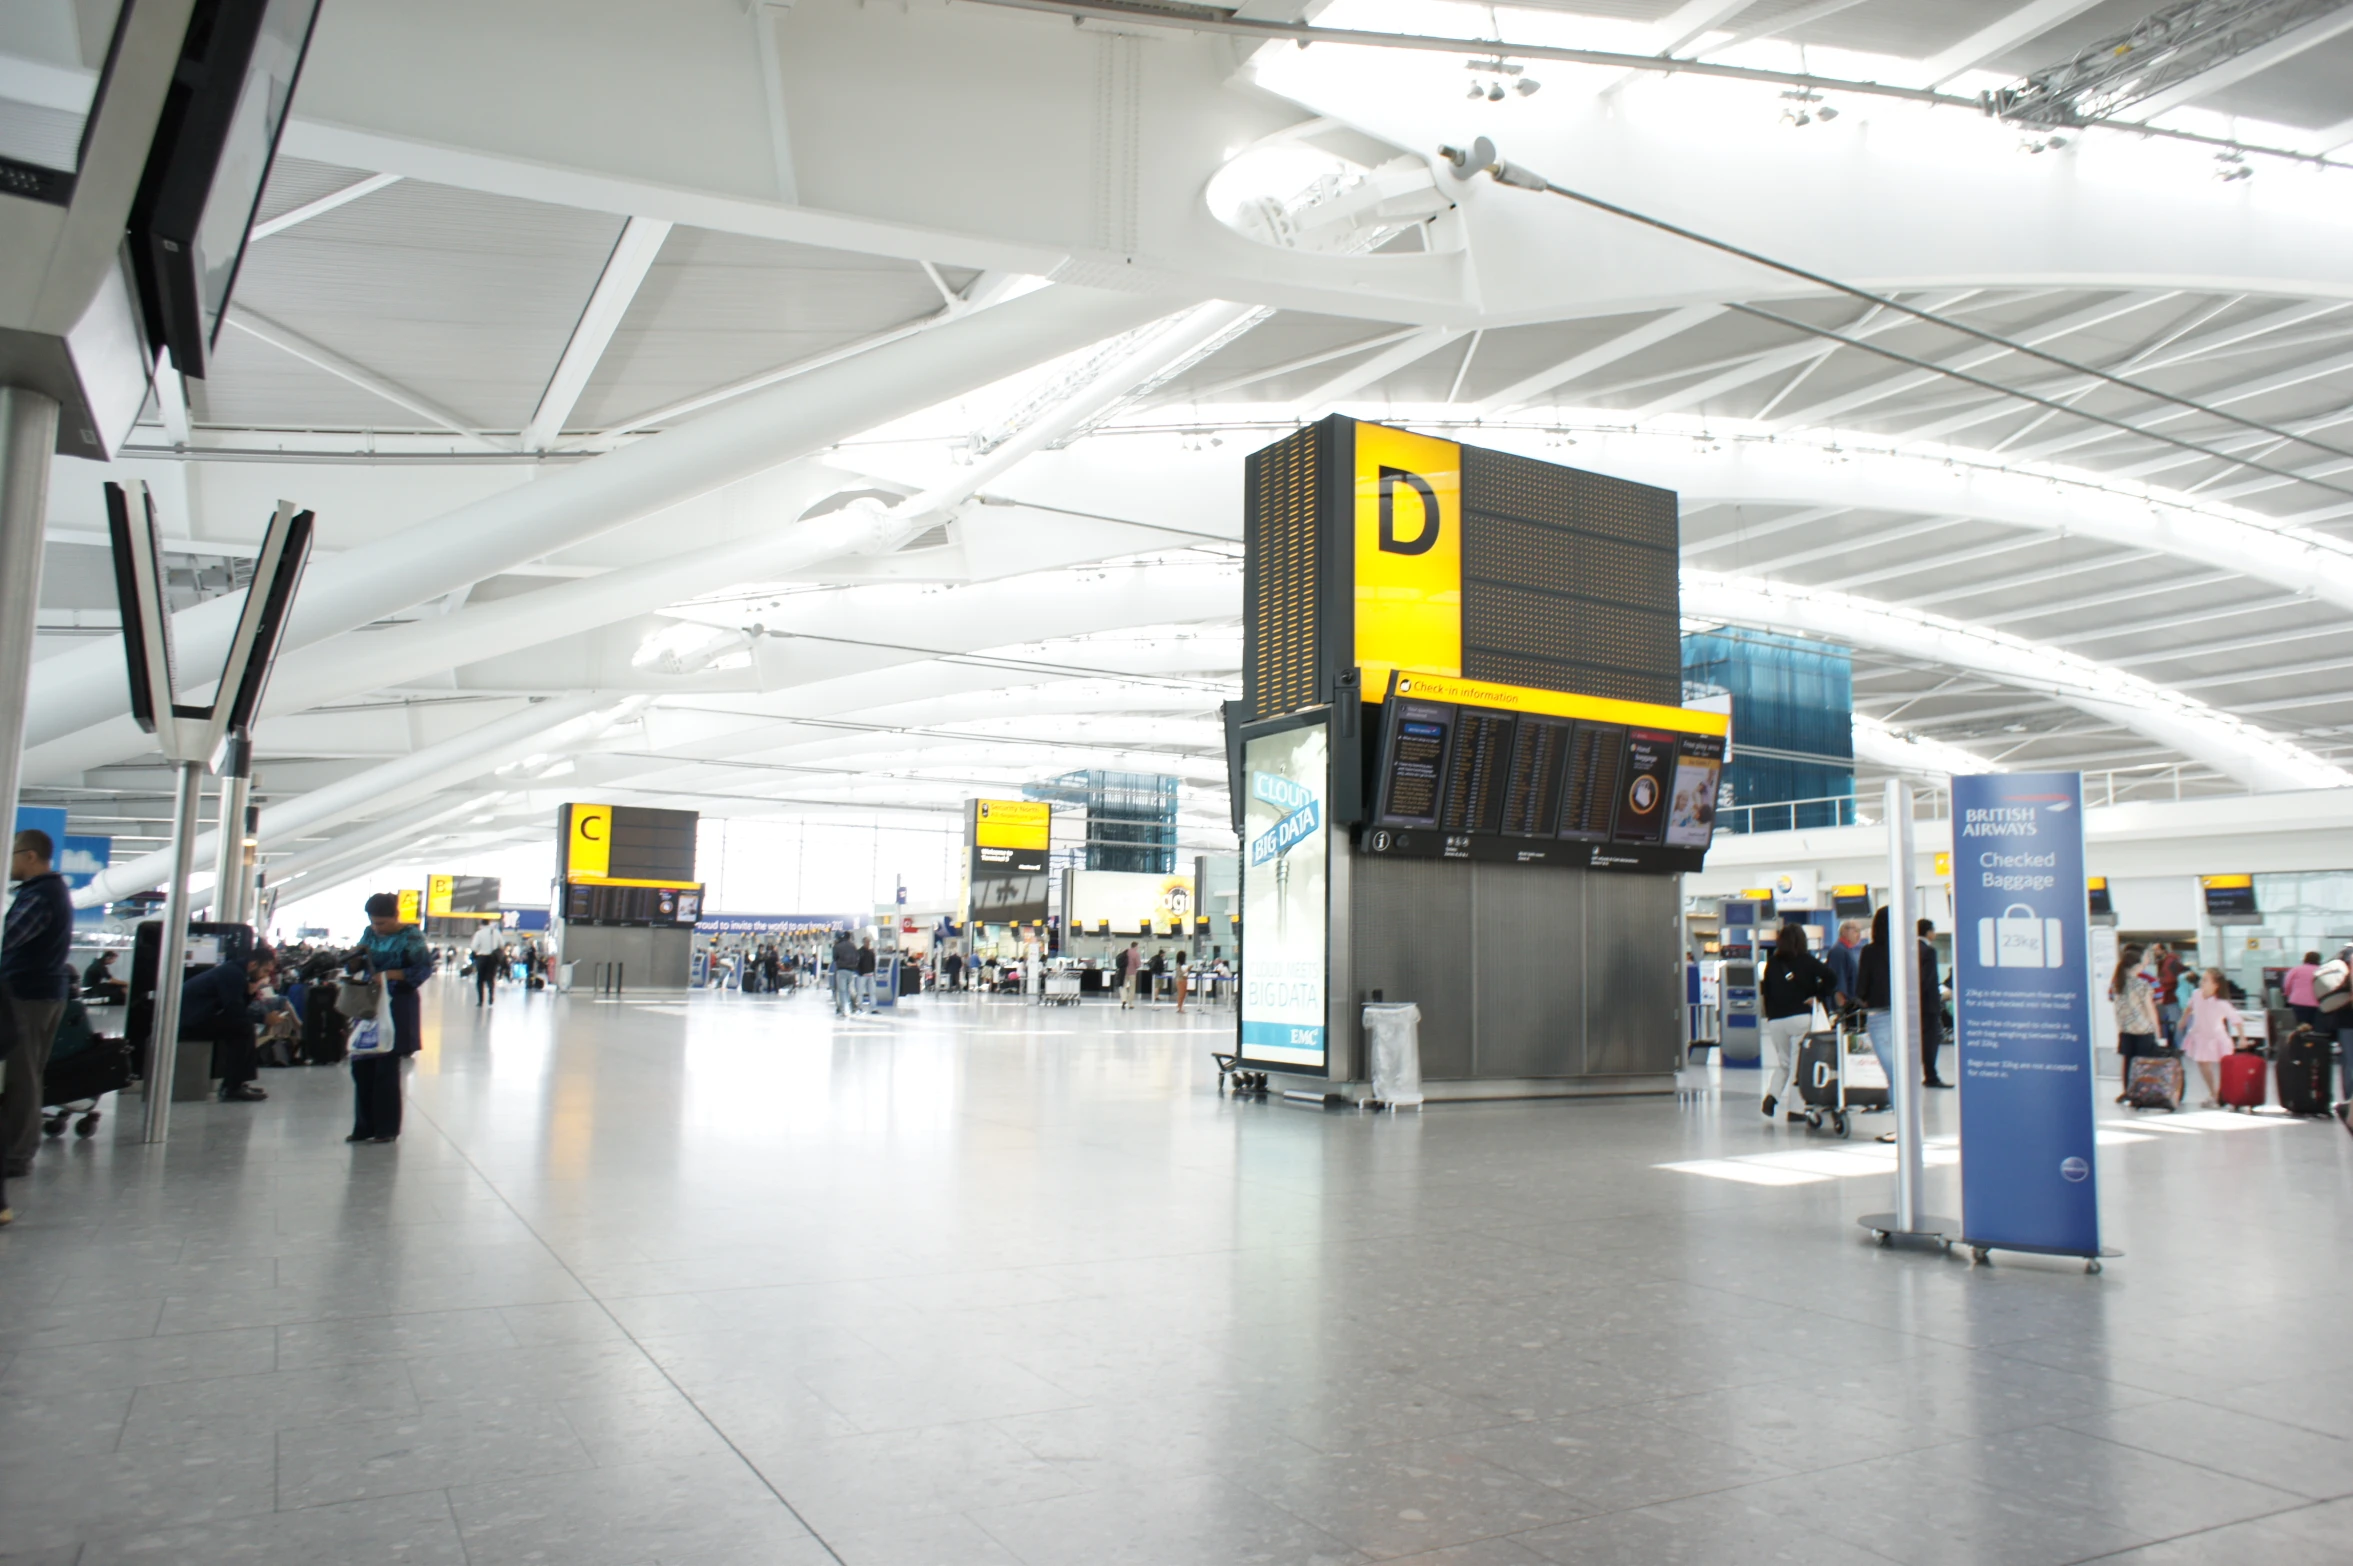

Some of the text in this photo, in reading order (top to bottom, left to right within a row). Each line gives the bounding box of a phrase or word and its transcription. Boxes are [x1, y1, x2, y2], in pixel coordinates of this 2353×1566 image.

[1379, 464, 1440, 556] D
[1413, 681, 1519, 703] Check-in information
[1257, 775, 1310, 808] CLOUD
[1965, 807, 2036, 823] BRITISH
[580, 815, 602, 841] C
[1255, 805, 1316, 861] BIG DATA
[1962, 822, 2038, 837] AIRWAYS
[1979, 851, 2056, 868] Checked
[435, 879, 446, 893] B
[1982, 871, 2055, 891] Baggage
[730, 920, 753, 930] invite
[753, 920, 767, 930] the
[768, 920, 788, 931] world
[2002, 934, 2040, 951] 23kg
